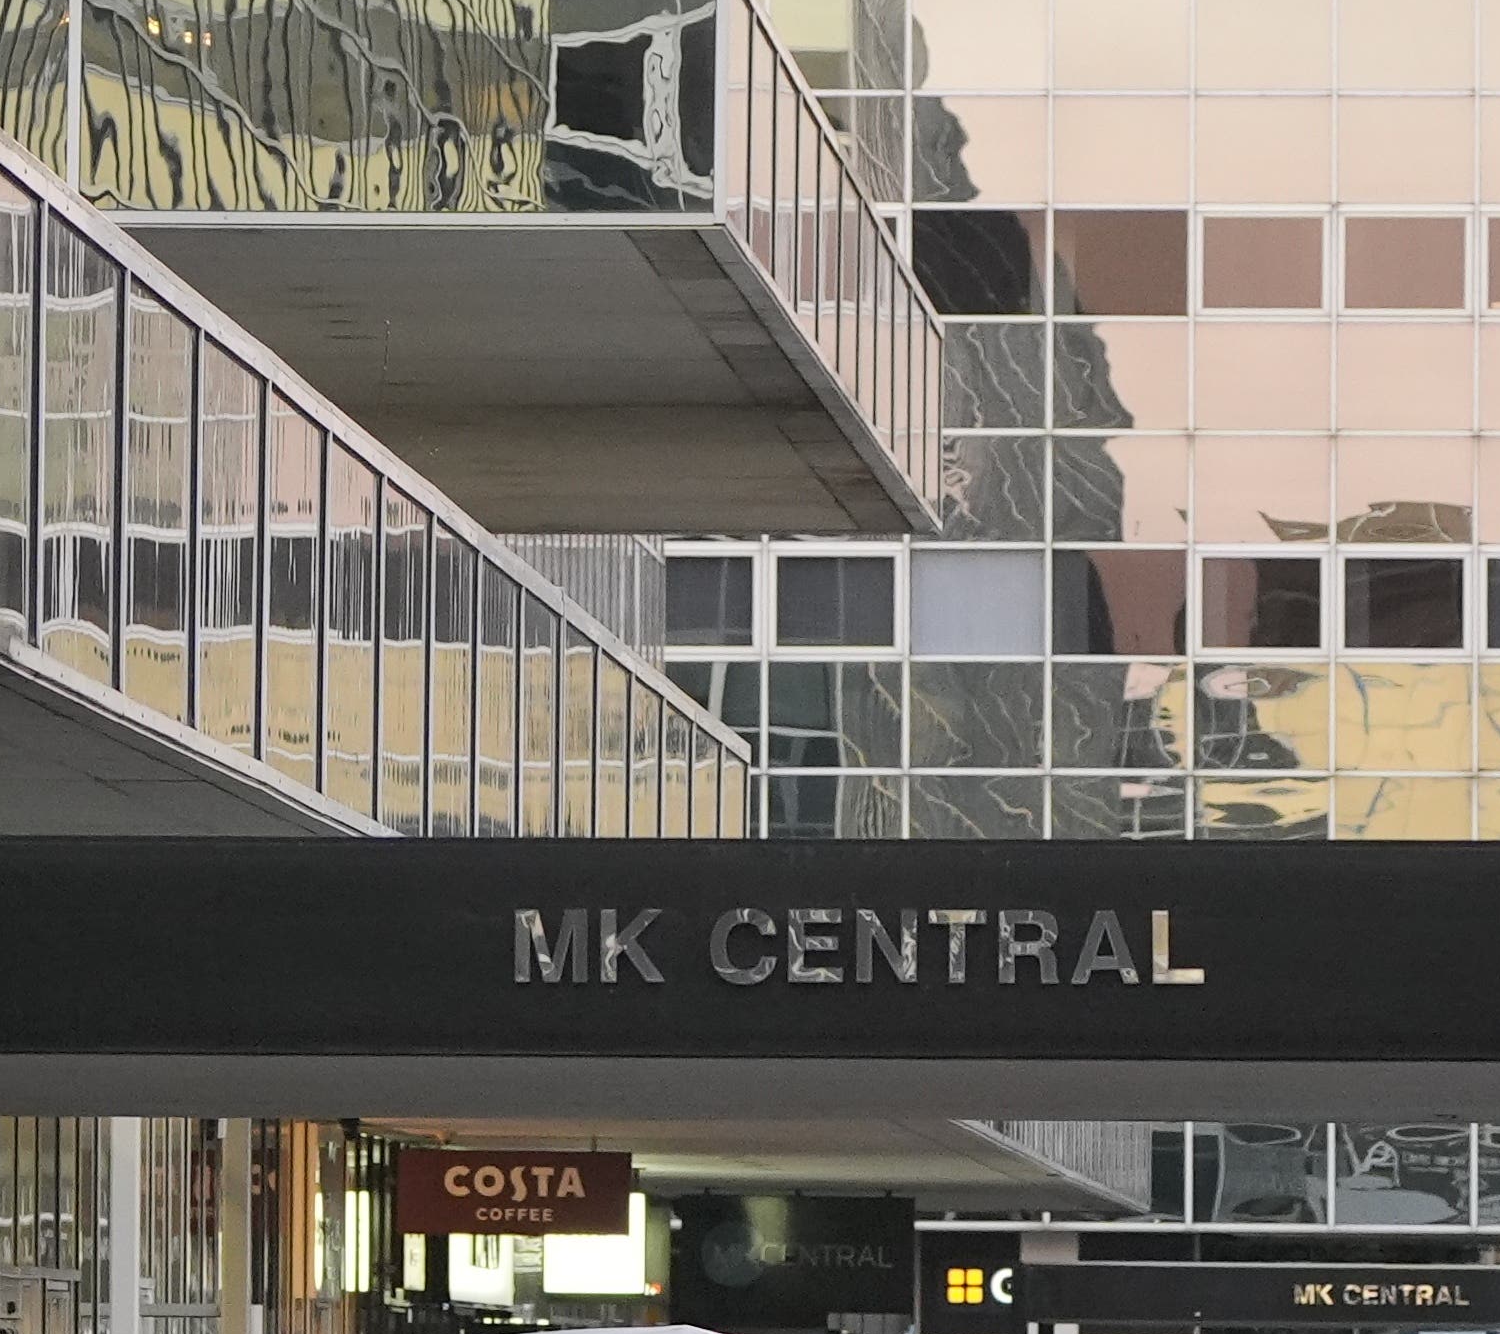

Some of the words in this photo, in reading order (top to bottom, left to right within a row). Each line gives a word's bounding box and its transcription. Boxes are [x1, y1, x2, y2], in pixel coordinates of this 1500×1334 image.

[514, 908, 666, 984] MK
[708, 907, 1207, 985] CENTRAL
[443, 1165, 586, 1203] COSTA
[475, 1207, 555, 1222] COFFEE
[1293, 1283, 1335, 1306] MK
[1343, 1283, 1471, 1306] CENTRAL
